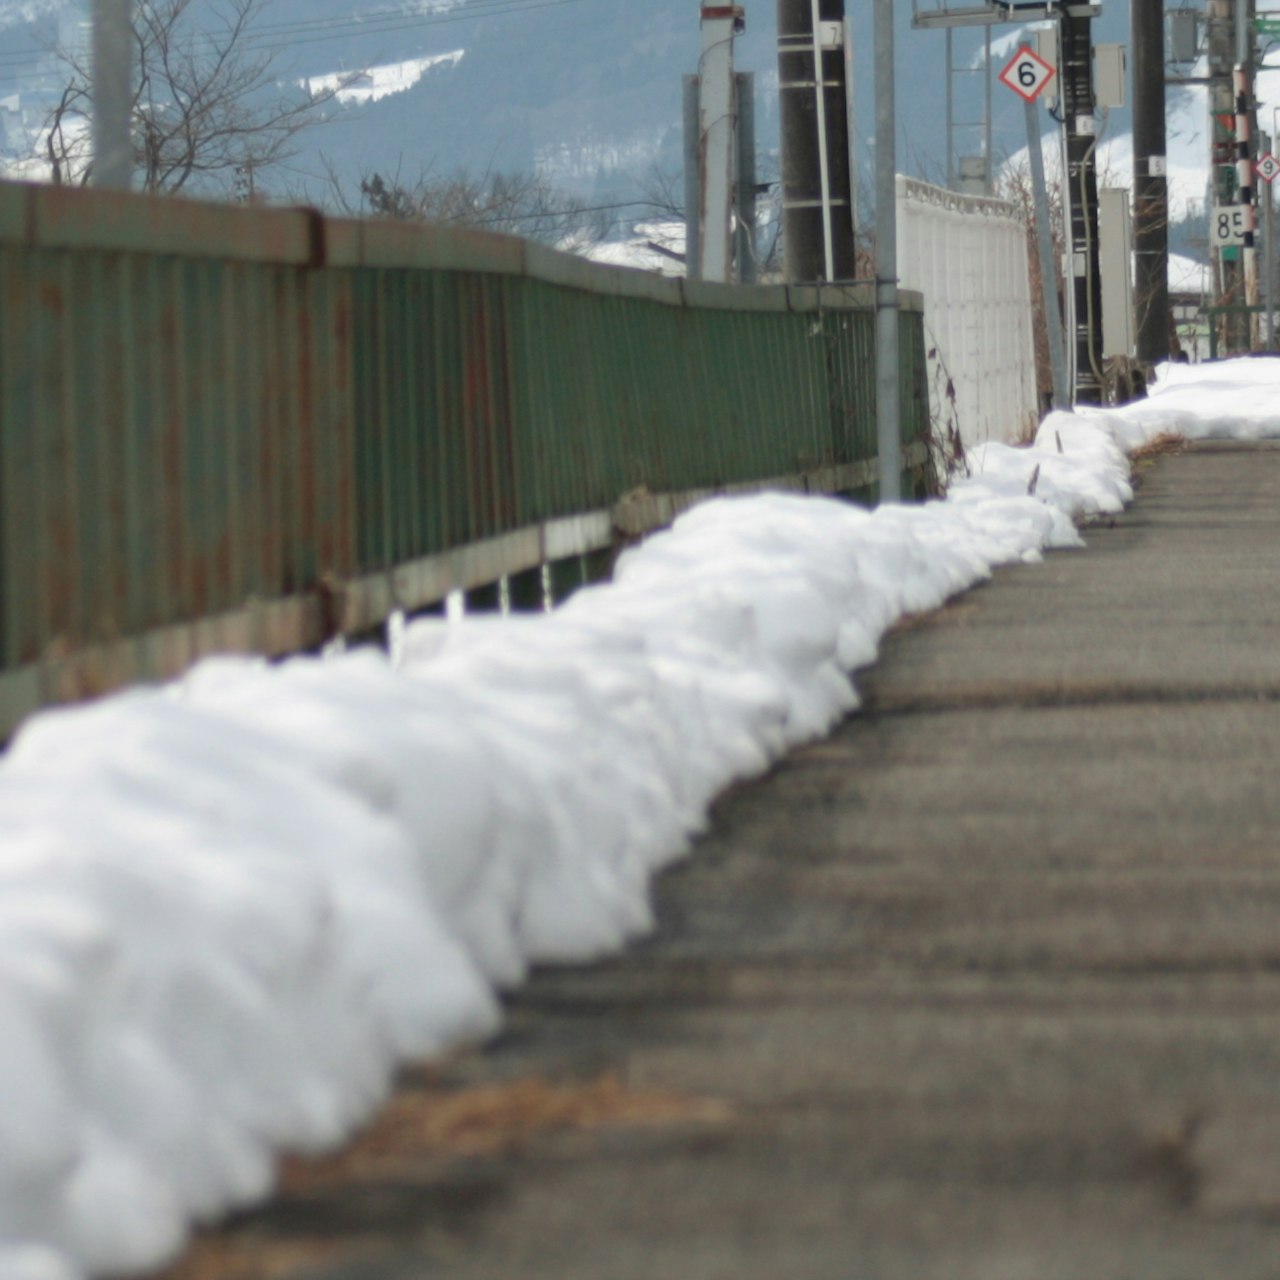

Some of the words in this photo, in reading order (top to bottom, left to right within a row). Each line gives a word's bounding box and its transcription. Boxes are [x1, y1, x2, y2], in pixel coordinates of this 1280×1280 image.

[1017, 61, 1037, 87] 6
[1262, 159, 1274, 175] 9
[1217, 212, 1246, 239] 85
